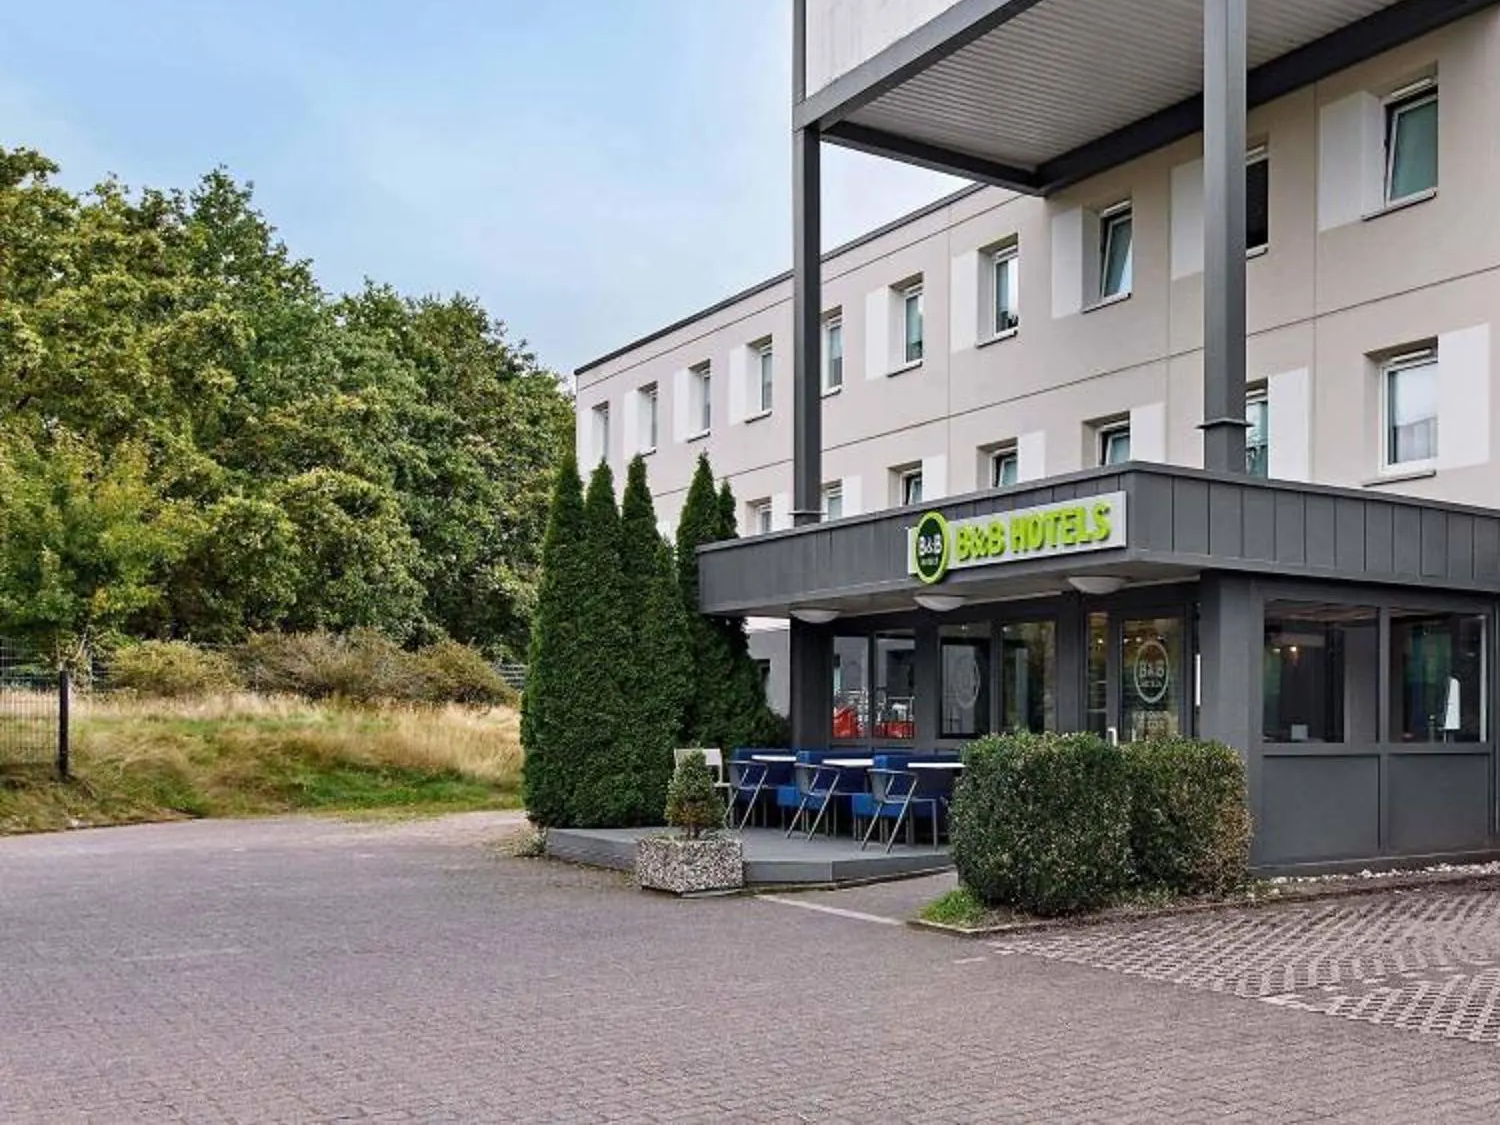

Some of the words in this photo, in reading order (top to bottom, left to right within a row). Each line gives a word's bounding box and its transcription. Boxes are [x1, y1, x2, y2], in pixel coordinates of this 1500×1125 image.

[919, 534, 942, 556] B&B
[956, 521, 1005, 562] B&B
[1009, 500, 1112, 554] HOTELS
